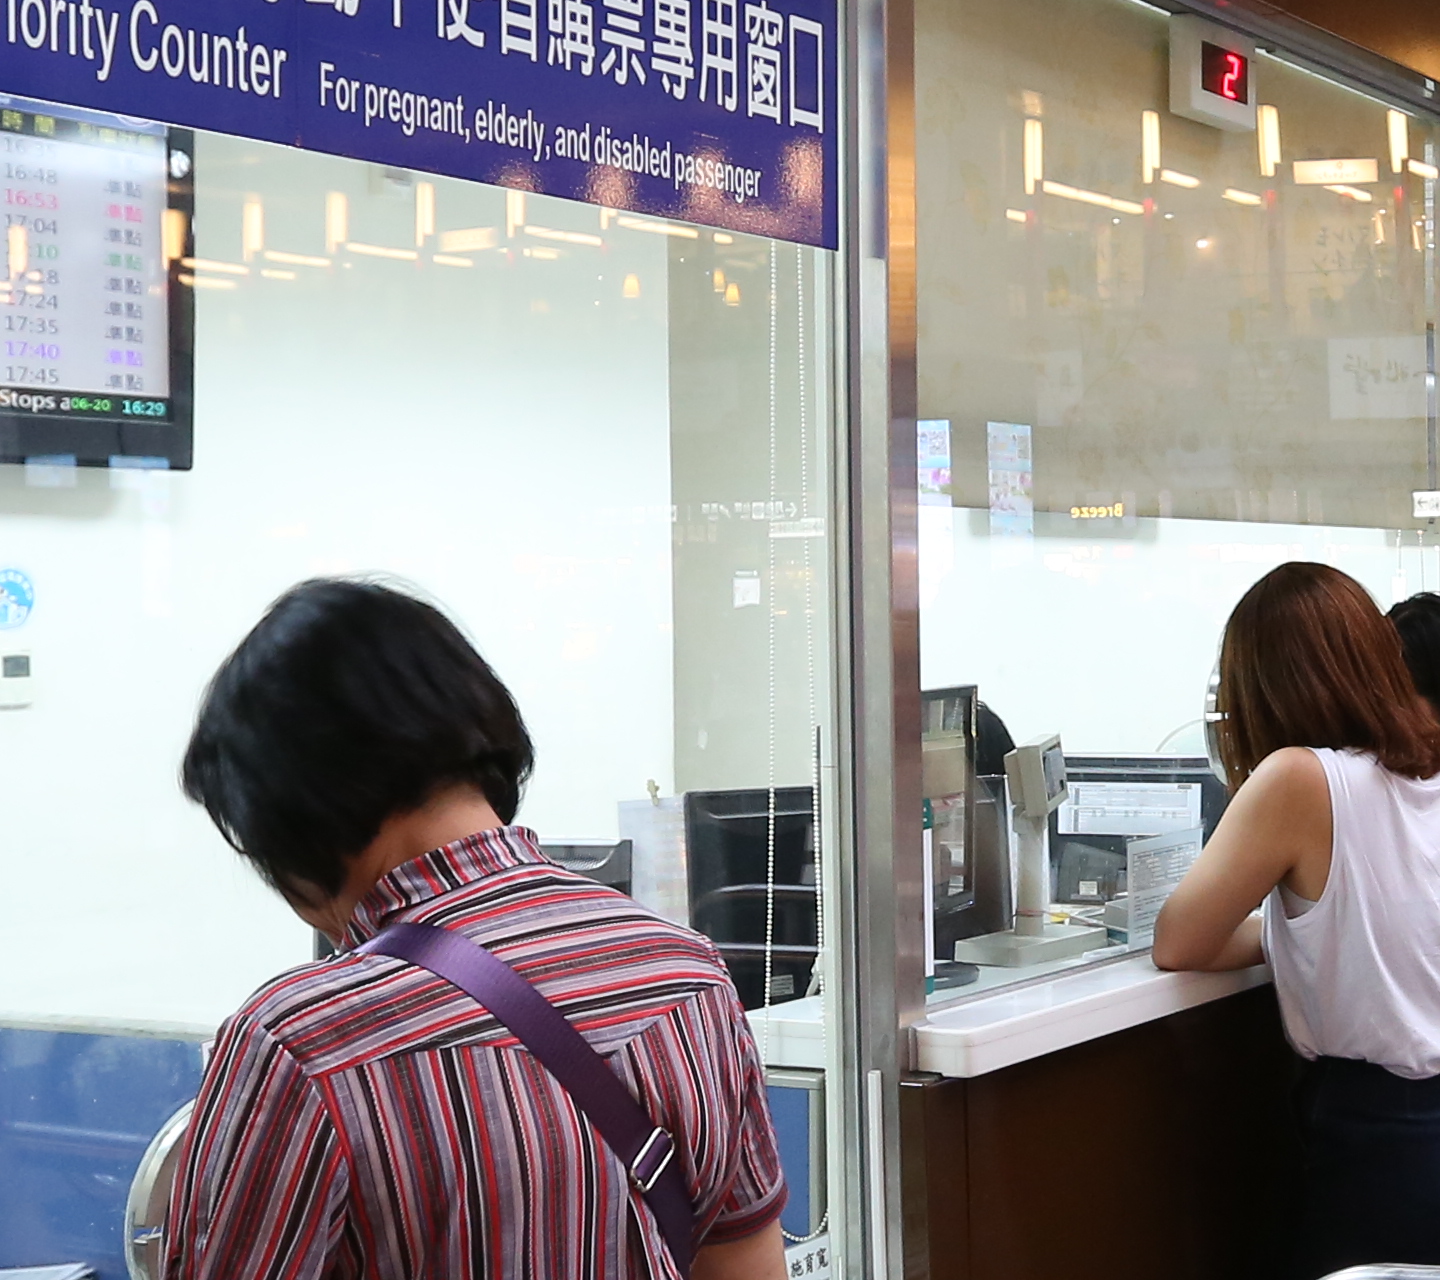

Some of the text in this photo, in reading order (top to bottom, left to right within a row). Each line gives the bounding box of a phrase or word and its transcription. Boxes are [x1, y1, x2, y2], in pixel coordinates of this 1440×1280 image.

[1222, 54, 1239, 100] 2
[319, 61, 359, 111] For
[363, 77, 471, 145] pregnant,
[475, 99, 550, 163] elderly,
[554, 123, 590, 158] and
[593, 127, 670, 181] disabled
[673, 151, 762, 204] passenger
[5, 162, 58, 186] 16:48
[4, 189, 58, 211] 16:53
[6, 313, 59, 336] 17:35
[6, 339, 60, 361] 17:40
[6, 365, 60, 385] 17:45
[70, 395, 113, 413] 06-20
[122, 399, 167, 418] 16:29
